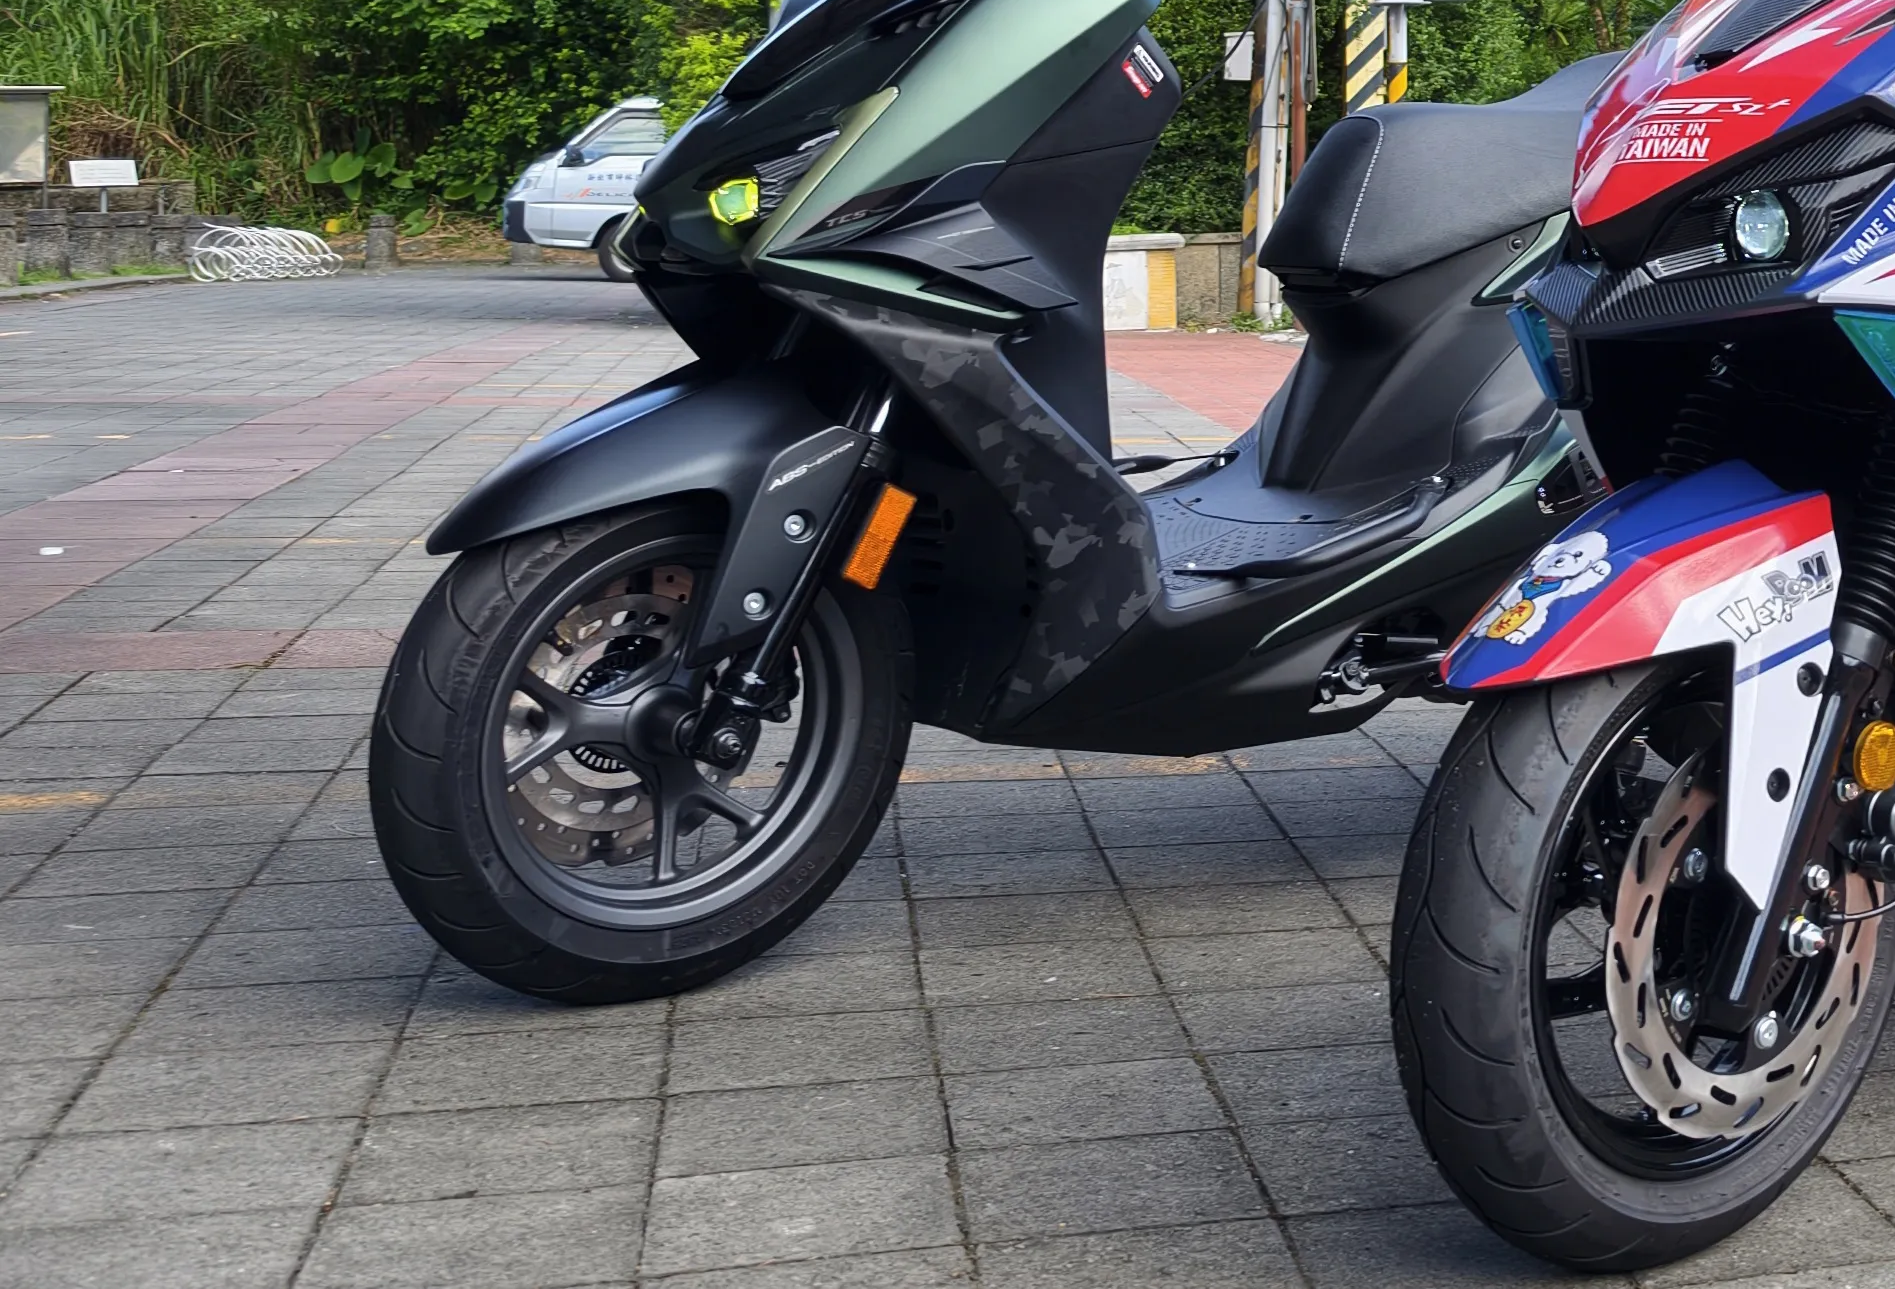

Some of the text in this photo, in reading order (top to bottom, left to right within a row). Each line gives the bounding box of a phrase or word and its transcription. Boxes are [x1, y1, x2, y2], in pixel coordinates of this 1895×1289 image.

[1631, 123, 1707, 139] MADE IN
[1618, 137, 1711, 161] TAIWAN
[826, 209, 869, 228] TCS
[1841, 217, 1889, 265] MADE
